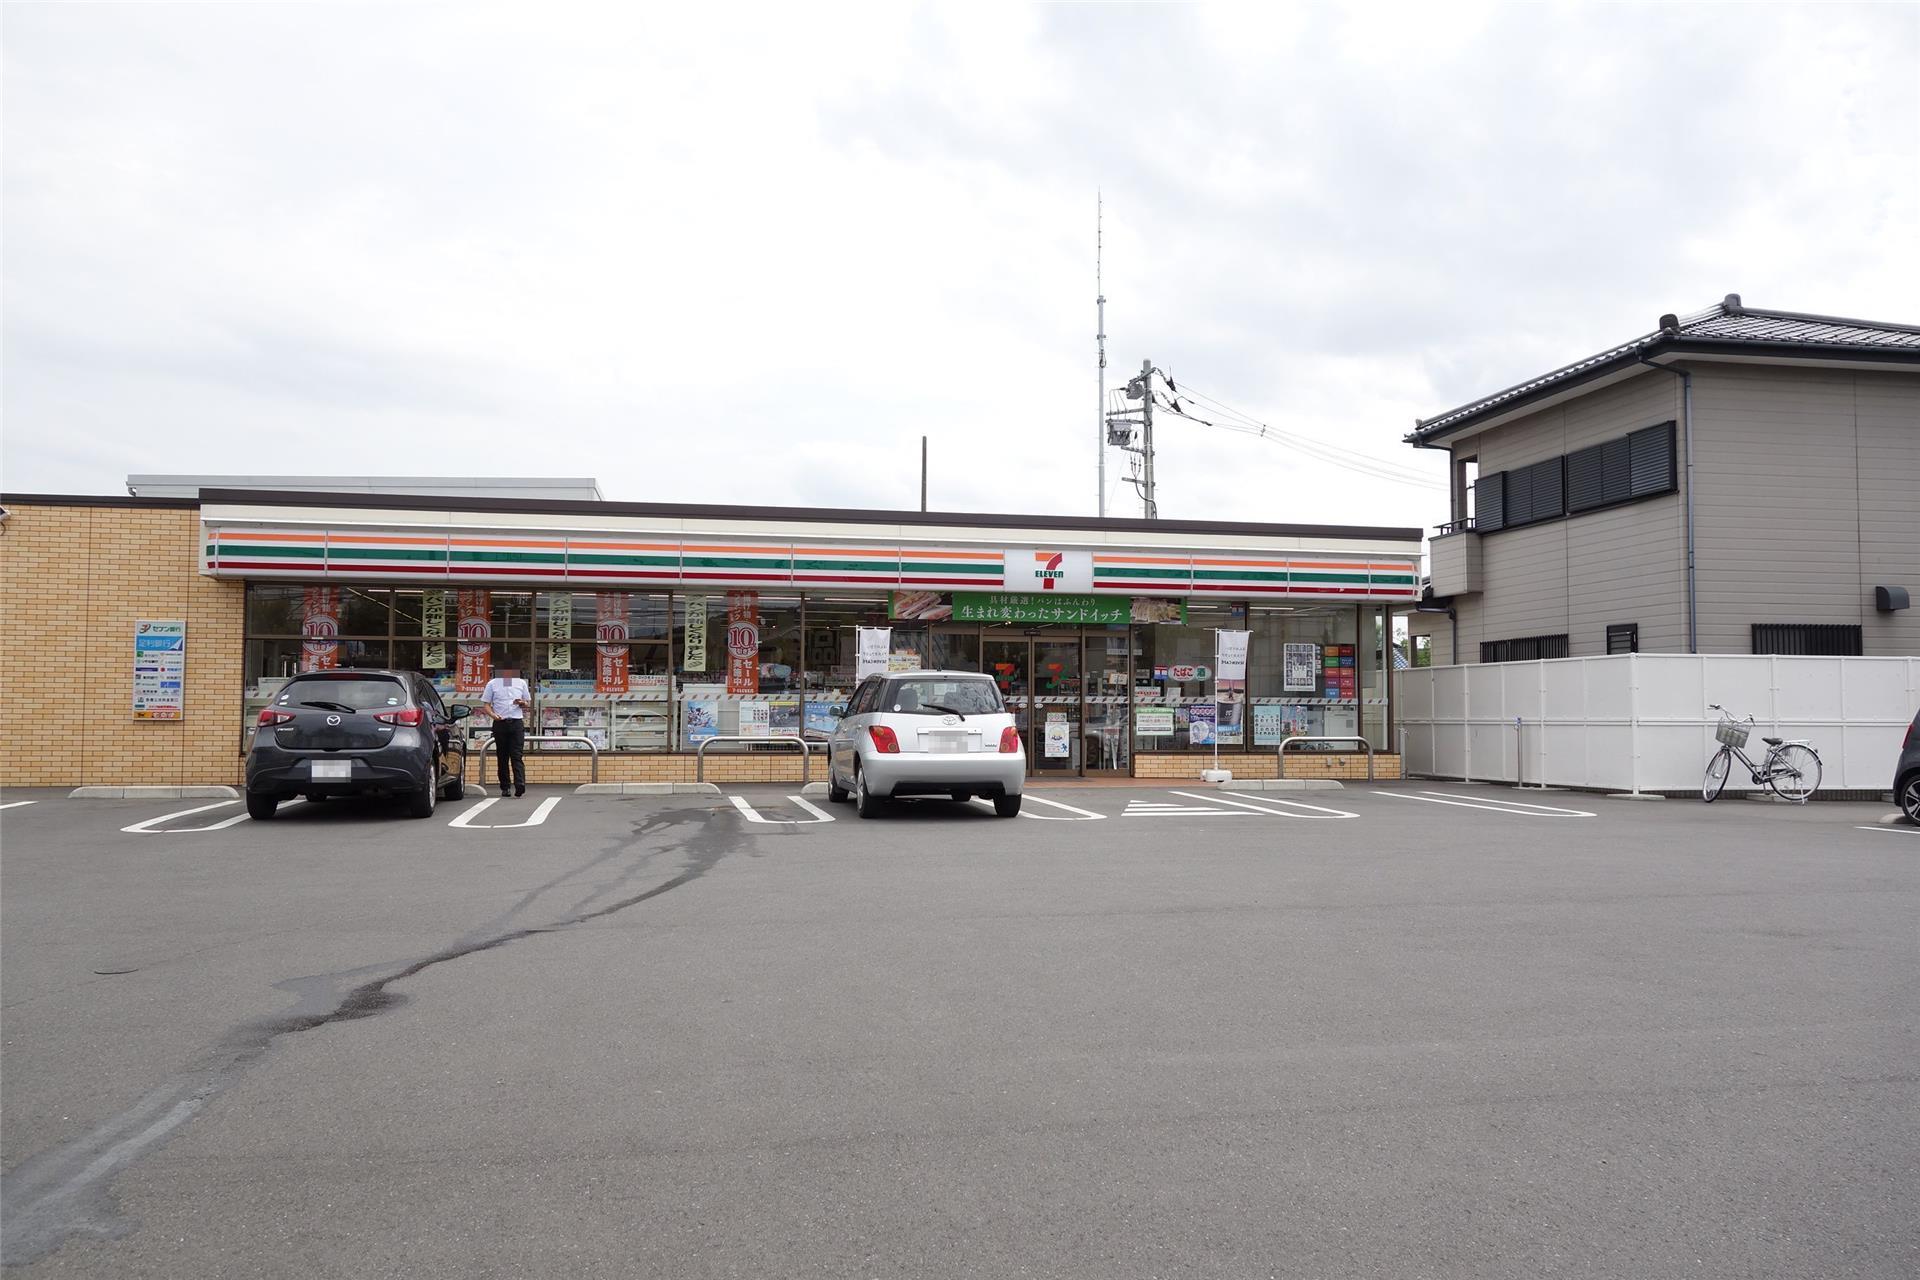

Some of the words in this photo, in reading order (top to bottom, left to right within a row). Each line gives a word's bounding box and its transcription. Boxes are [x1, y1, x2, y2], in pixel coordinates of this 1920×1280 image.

[1035, 552, 1063, 590] 7
[961, 605, 1123, 621] 生まれ変わったサンドイッチ
[474, 656, 484, 684] セール
[613, 657, 624, 684] セール
[743, 659, 753, 686] セール
[1173, 667, 1193, 677] たばこ
